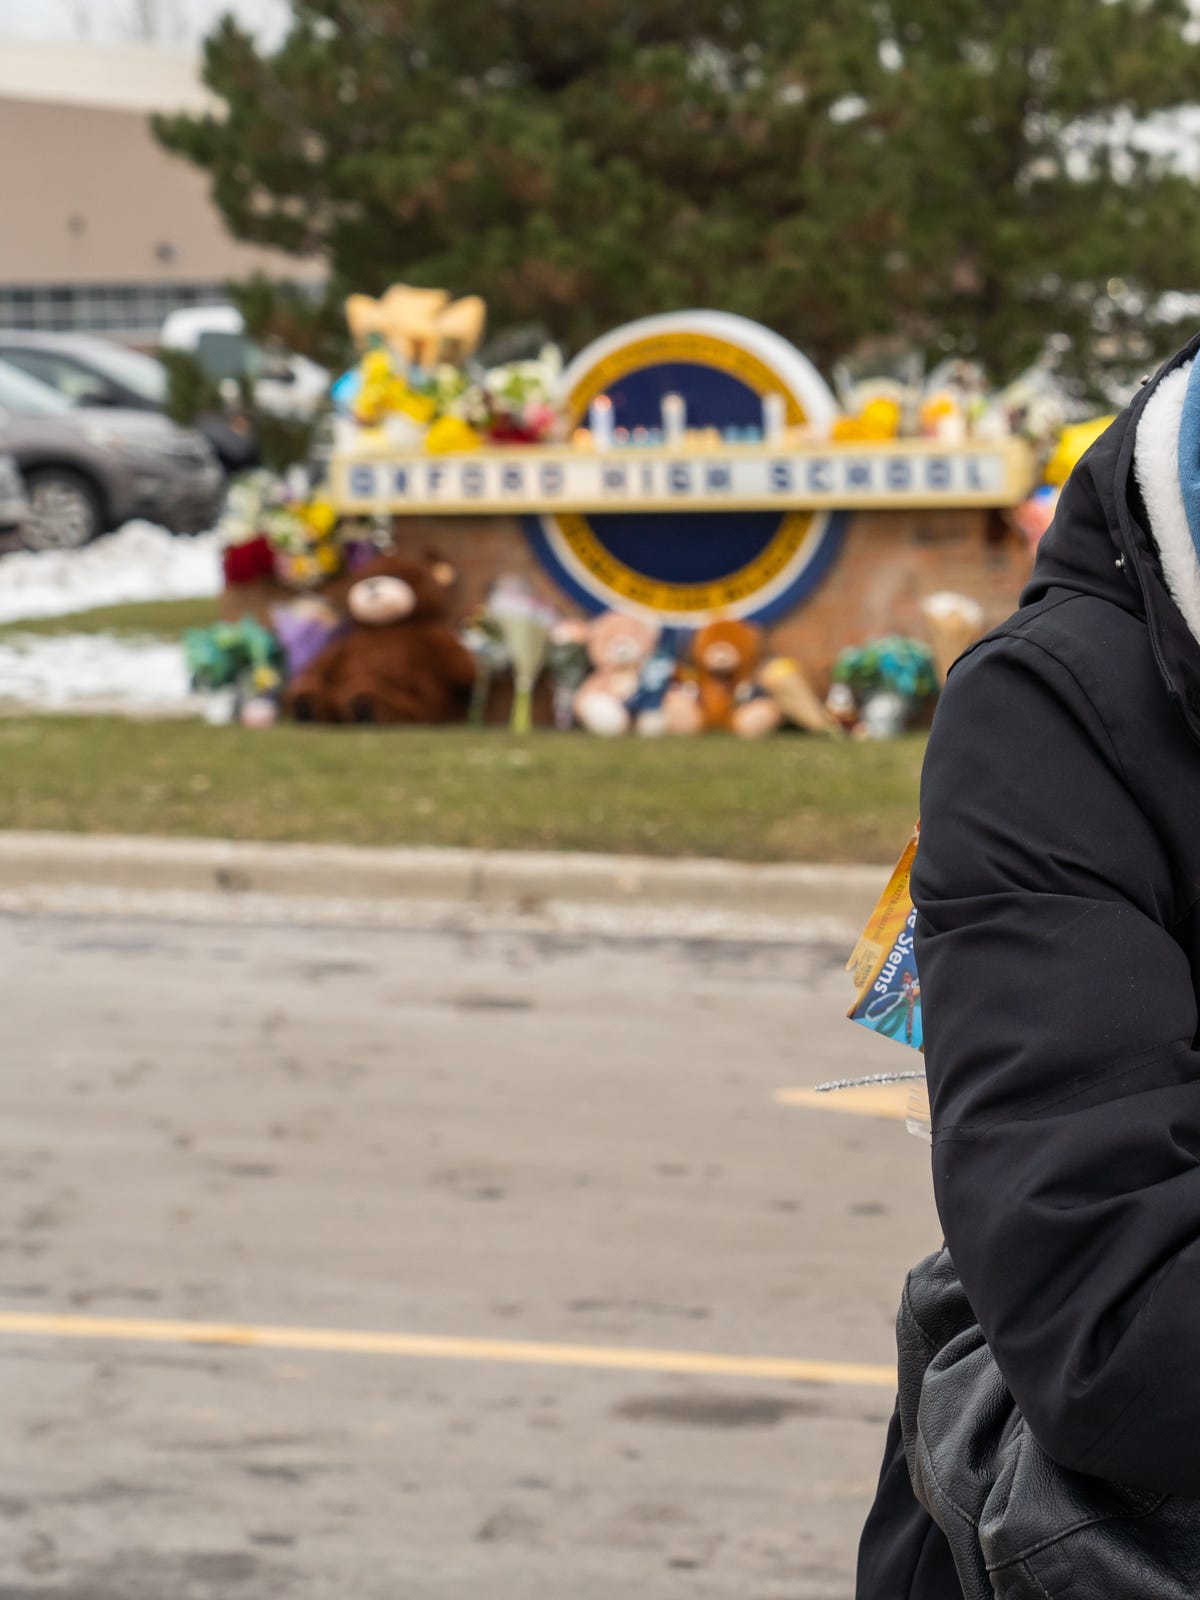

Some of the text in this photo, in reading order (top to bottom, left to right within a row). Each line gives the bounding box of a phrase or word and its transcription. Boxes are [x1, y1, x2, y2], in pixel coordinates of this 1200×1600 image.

[350, 456, 988, 499] OXFORD HIGH SCHOOL
[873, 932, 914, 994] Stems
